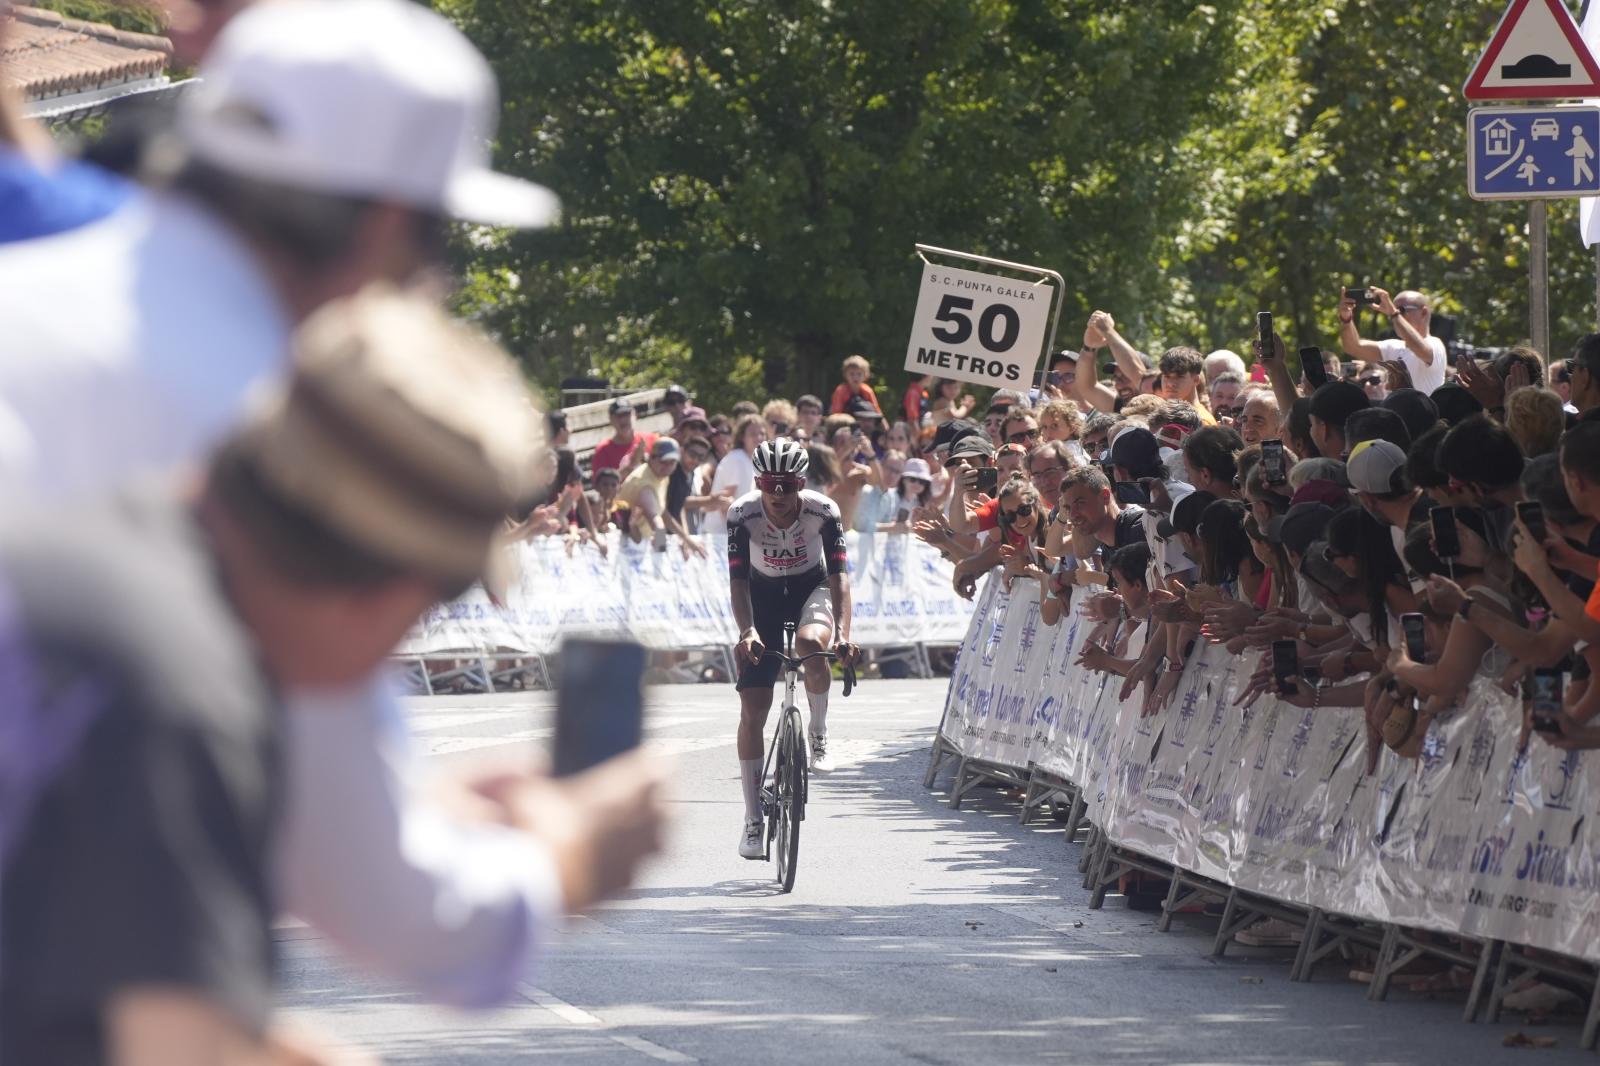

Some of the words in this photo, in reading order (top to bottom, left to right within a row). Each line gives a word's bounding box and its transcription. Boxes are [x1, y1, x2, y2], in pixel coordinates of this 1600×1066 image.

[997, 286, 1035, 301] GALEA
[931, 294, 1021, 353] 50
[916, 347, 1021, 381] METROS
[763, 545, 807, 559] UAE
